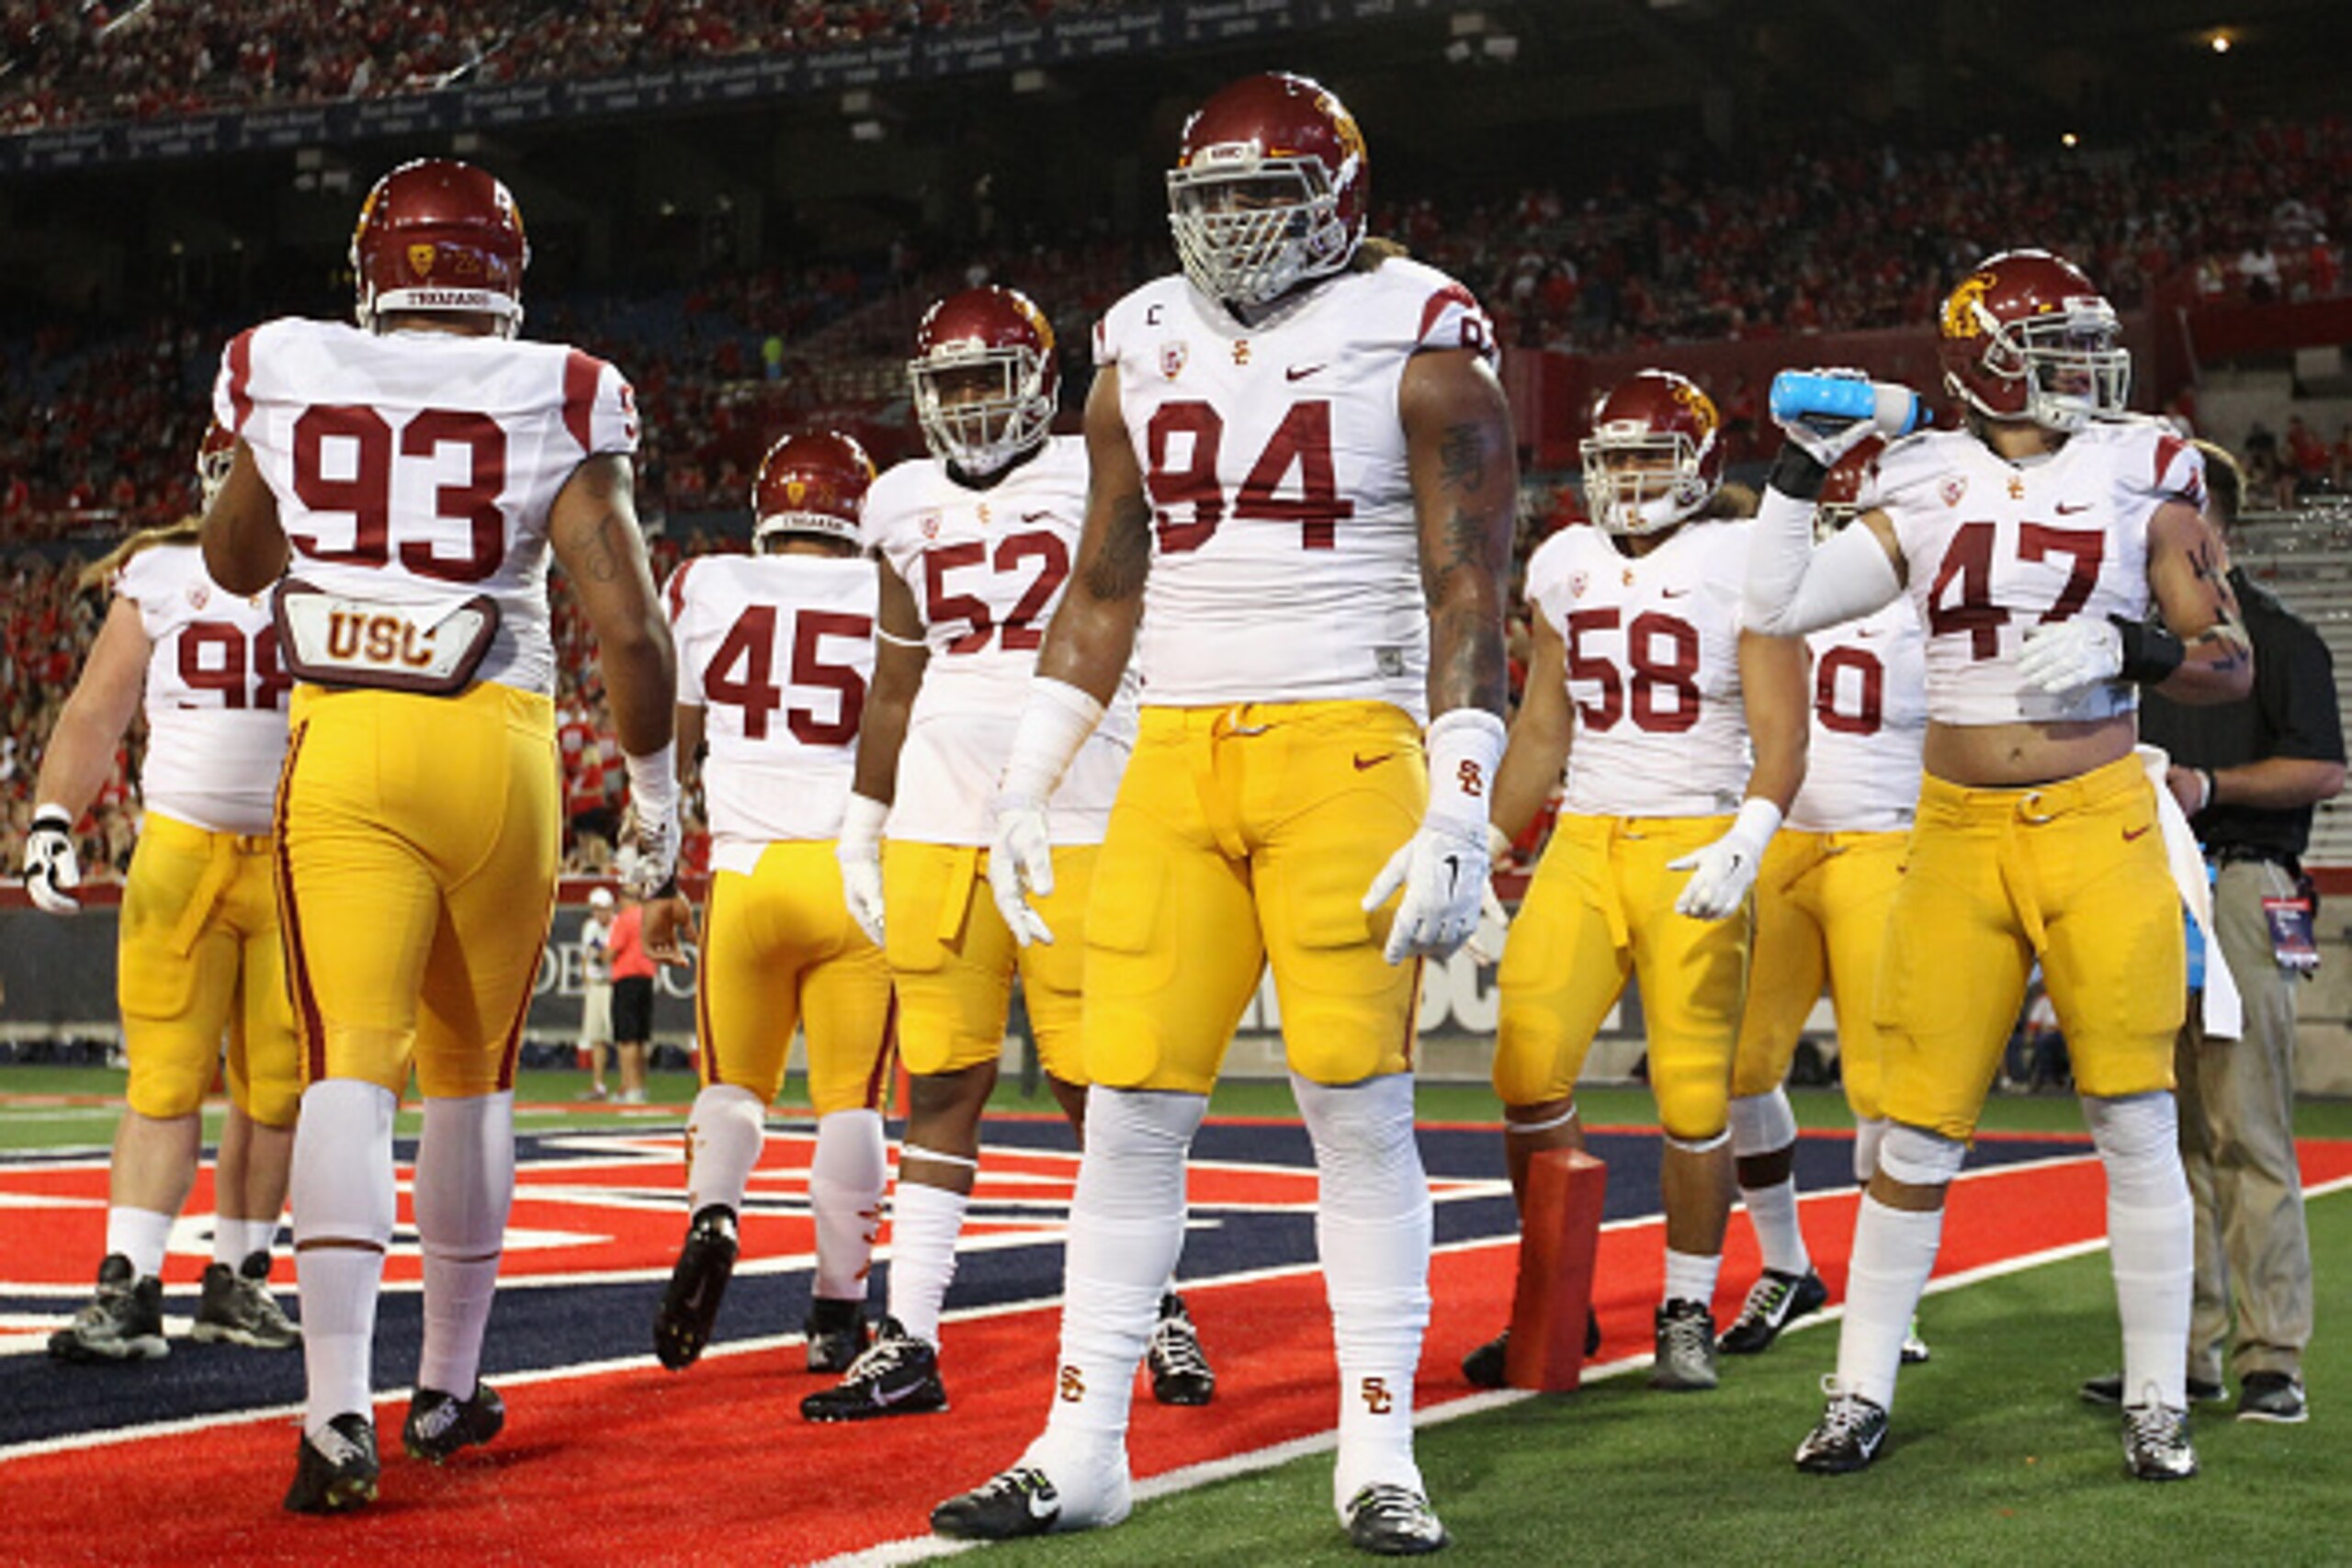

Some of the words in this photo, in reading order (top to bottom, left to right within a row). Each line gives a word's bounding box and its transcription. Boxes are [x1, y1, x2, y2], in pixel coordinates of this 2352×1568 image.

[289, 403, 507, 583] 93
[1146, 400, 1355, 554] 94
[922, 530, 1071, 655] 52
[1927, 521, 2106, 661] 47
[704, 604, 873, 747] 45
[1565, 605, 1701, 734] 58
[1804, 643, 1884, 736] 0
